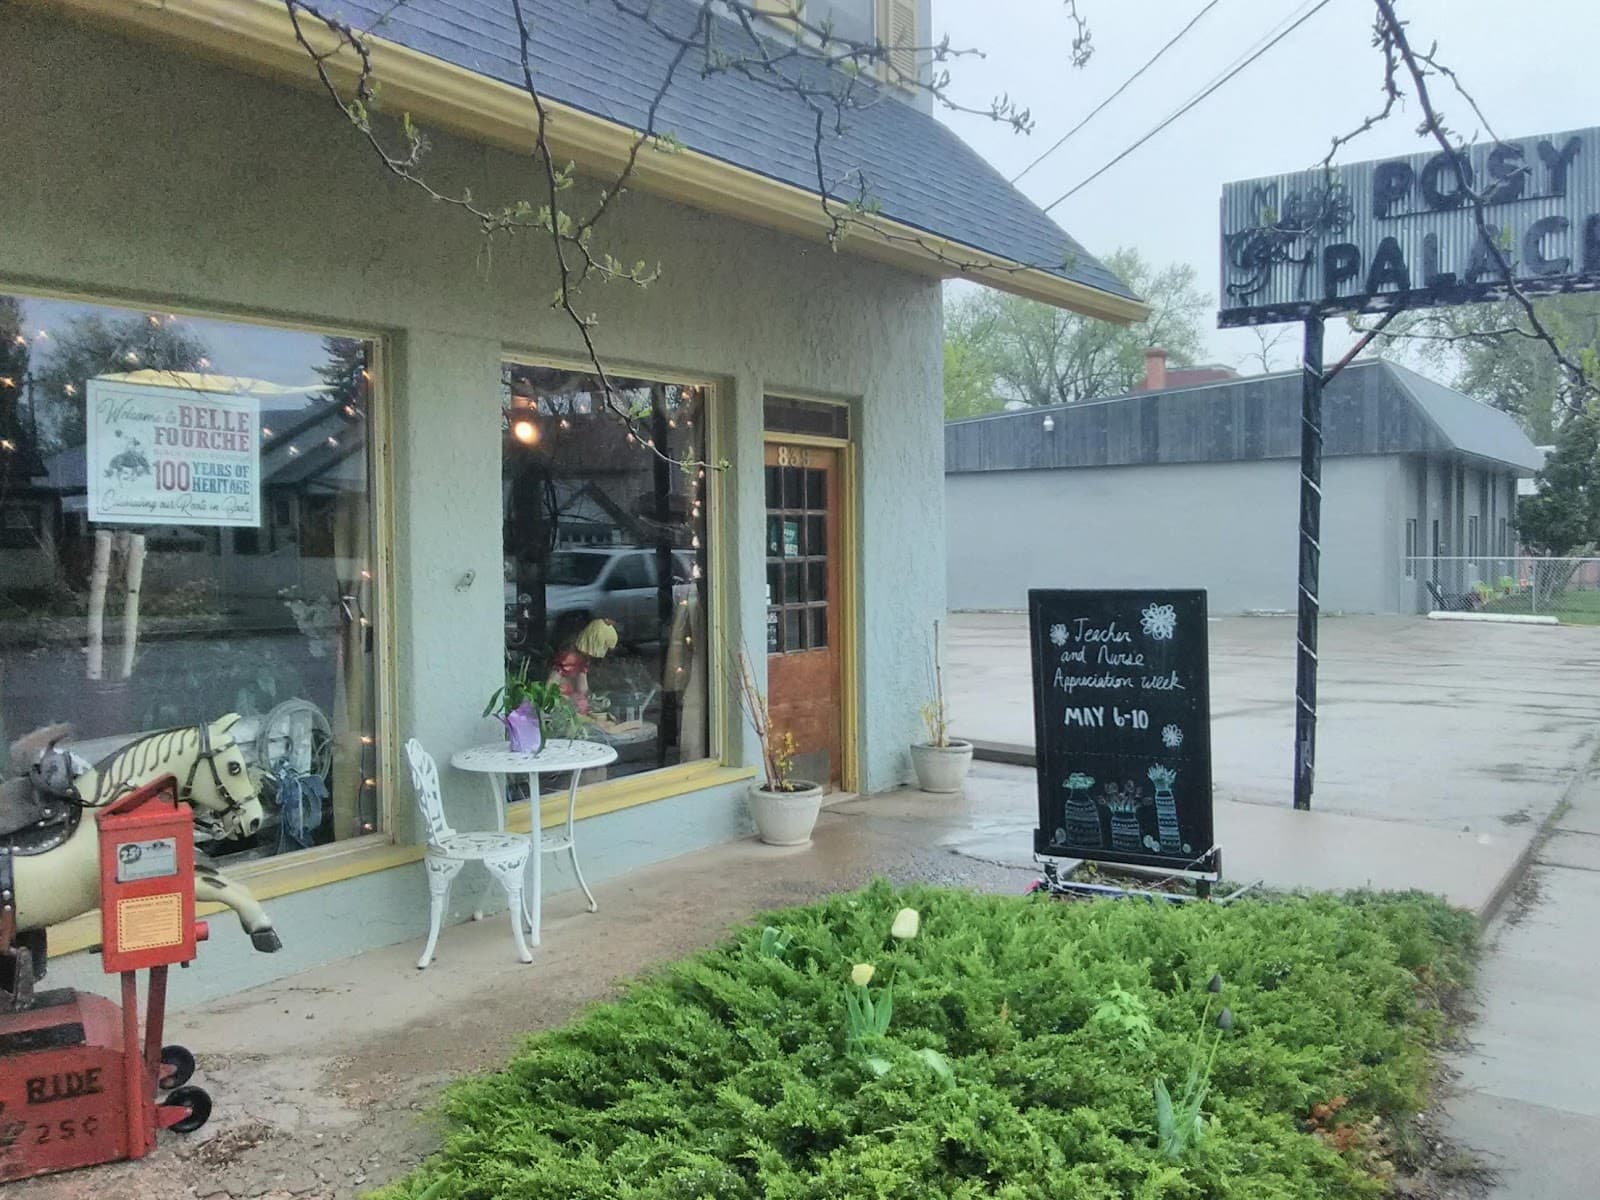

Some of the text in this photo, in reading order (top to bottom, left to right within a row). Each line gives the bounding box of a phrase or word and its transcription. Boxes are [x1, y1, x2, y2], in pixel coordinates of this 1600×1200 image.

[1373, 136, 1582, 219] POSY
[97, 398, 161, 425] Welcome
[178, 405, 249, 433] BELLE
[154, 426, 249, 452] FOURCHE
[153, 460, 250, 492] 100 YEARS OF
[192, 477, 250, 495] HERITAGE
[1073, 617, 1132, 642] Teacher
[1060, 644, 1145, 666] and Nurse
[1053, 666, 1186, 694] Appreciation week
[1064, 706, 1149, 729] MAY 6-10
[26, 1067, 103, 1104] RIDE
